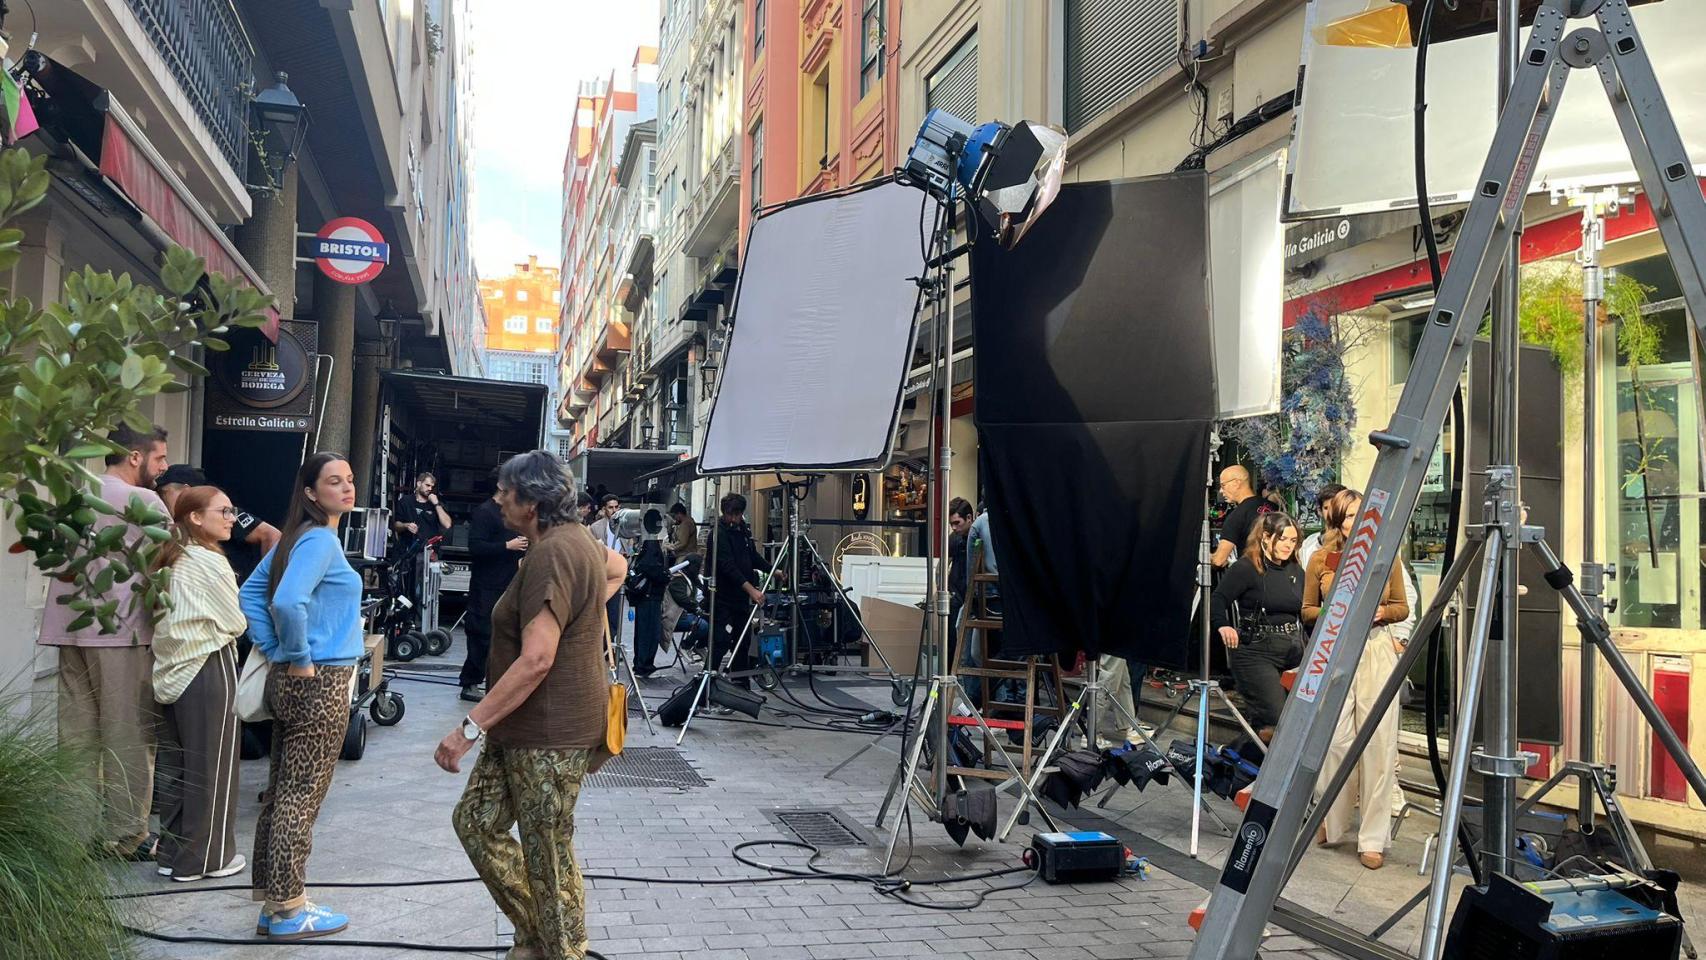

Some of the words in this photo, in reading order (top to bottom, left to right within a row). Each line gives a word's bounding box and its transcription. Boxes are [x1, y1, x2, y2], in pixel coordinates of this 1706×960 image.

[1299, 228, 1334, 253] Galicia
[320, 242, 380, 257] BRISTOL
[241, 371, 286, 379] CERVEZA
[241, 382, 286, 390] BODEGA
[215, 415, 256, 427] Estrella
[257, 416, 295, 428] Galicia
[1233, 830, 1257, 871] filamento
